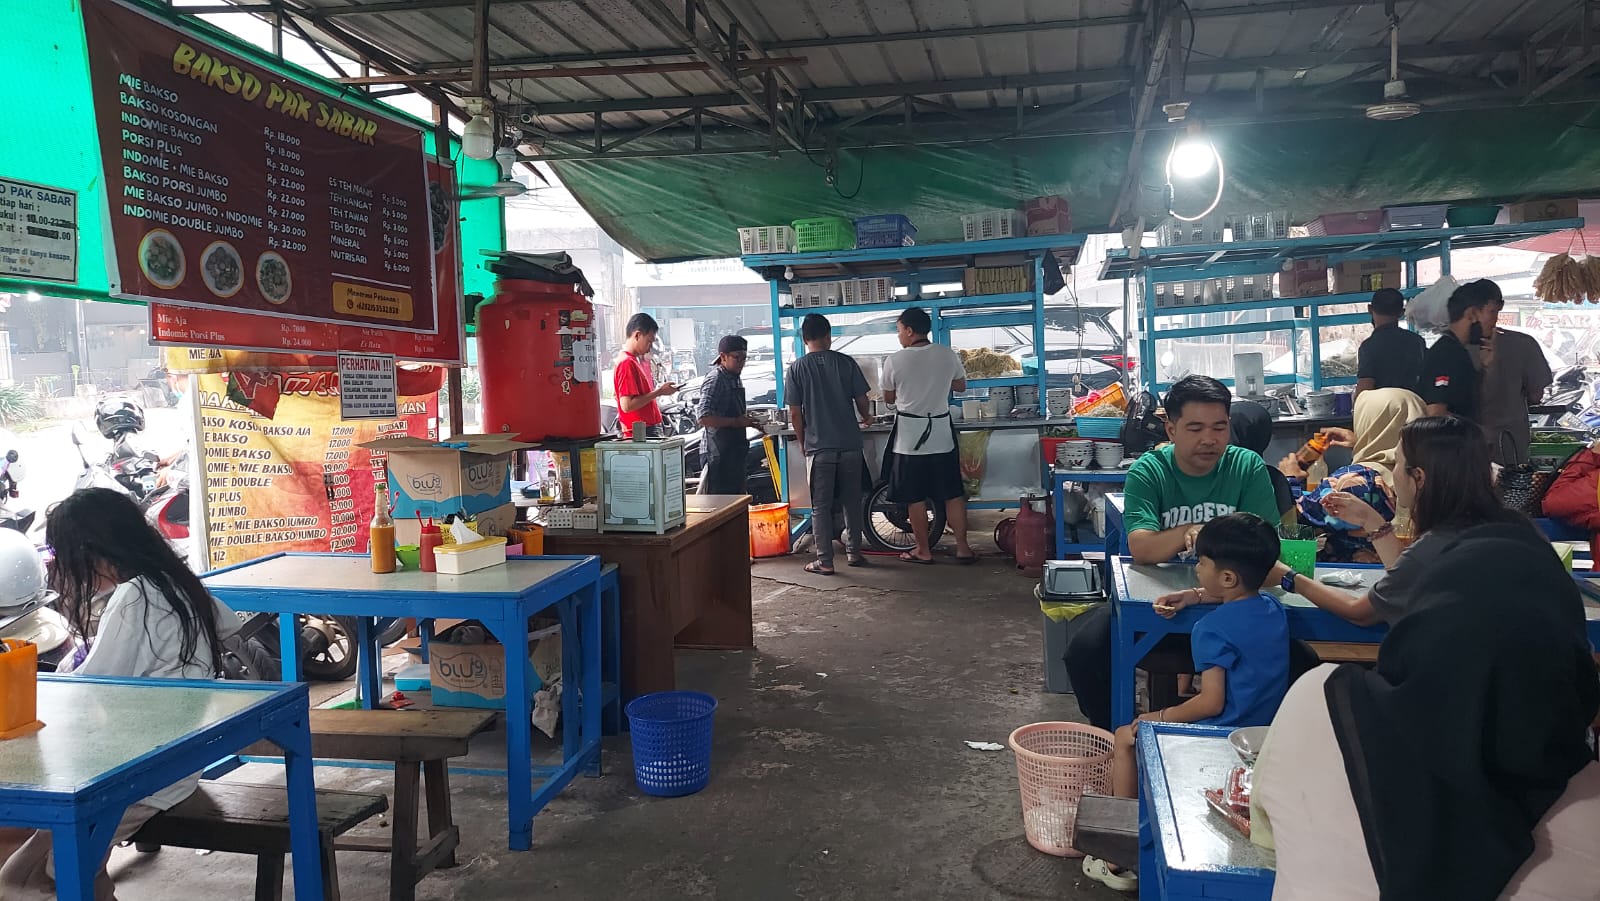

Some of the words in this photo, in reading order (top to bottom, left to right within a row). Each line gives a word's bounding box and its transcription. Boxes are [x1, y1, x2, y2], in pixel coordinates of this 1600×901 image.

[120, 73, 142, 89] MIE
[143, 82, 178, 103] BAKSO
[173, 42, 262, 101] BAKSO
[265, 82, 311, 122] PAK
[315, 102, 378, 146] SABAR
[120, 91, 159, 113] BAKSO
[161, 107, 217, 132] KOSONGAN
[121, 111, 169, 135] INDOMIE
[170, 125, 202, 146] BAKSO
[264, 126, 275, 140] Rp.
[277, 131, 301, 146] 18.000
[122, 129, 154, 148] PORSI
[157, 140, 182, 156] PLUS
[265, 142, 276, 155] Rp.
[123, 149, 169, 170] INDOMIE
[180, 163, 197, 178] MIE
[198, 169, 229, 187] BAKSO
[266, 158, 278, 171] Rp.
[280, 163, 305, 177] 20.000
[123, 166, 159, 185] BAKSO
[162, 177, 194, 194] PORSI
[197, 187, 227, 203] JUMBO
[267, 173, 279, 187] Rp.
[280, 178, 306, 192] 22.000
[329, 177, 338, 187] ES
[338, 180, 352, 192] TEH
[10, 186, 33, 199] PAK
[37, 191, 72, 206] SABAR
[267, 189, 279, 202] Rp.
[280, 193, 306, 206] 22.000
[329, 192, 343, 202] TEH
[344, 197, 373, 211] HANGAT
[19, 199, 35, 211] hari
[124, 185, 145, 200] MIE
[146, 190, 182, 208] BAKSO
[185, 201, 218, 217] JUMBO
[226, 210, 263, 228] INDOMIE
[267, 205, 279, 218] Rp.
[280, 209, 305, 222] 27.000
[329, 206, 343, 217] TEH
[344, 210, 369, 223] TAWAR
[123, 204, 169, 224] INDOMIE
[171, 215, 212, 232] DOUBLE
[215, 224, 243, 240] JUMBO
[267, 221, 280, 233] Rp.
[281, 224, 306, 237] 30.000
[330, 221, 344, 231] TEH
[344, 223, 367, 237] BOTOL
[268, 236, 280, 249] Rp.
[281, 240, 307, 252] 32.000
[330, 234, 361, 249] MINERAL
[330, 249, 368, 264] NUTRISARI
[157, 313, 172, 324] Mie
[175, 316, 188, 327] Aja
[157, 327, 188, 338] Indomie
[190, 330, 209, 340] Porsi
[210, 331, 226, 341] Plus
[189, 349, 206, 360] MIE
[341, 358, 381, 372] PERHATIAN
[212, 432, 249, 445] BAKSO
[263, 426, 294, 436] BAKSO
[295, 427, 312, 436] AJA
[231, 448, 272, 460] BAKSO
[238, 462, 261, 473] MIE
[324, 463, 348, 473] 19.000
[231, 477, 272, 487] DOUBLE
[219, 491, 242, 502] PLUS
[217, 506, 247, 517] JUMBO
[331, 512, 355, 524] 30.000
[234, 520, 251, 530] MIE
[253, 518, 285, 529] BAKSO
[331, 525, 357, 537] 30.000
[226, 533, 263, 546] DOUBLE
[264, 531, 296, 543] BAKSO
[213, 550, 226, 562] 1/2
